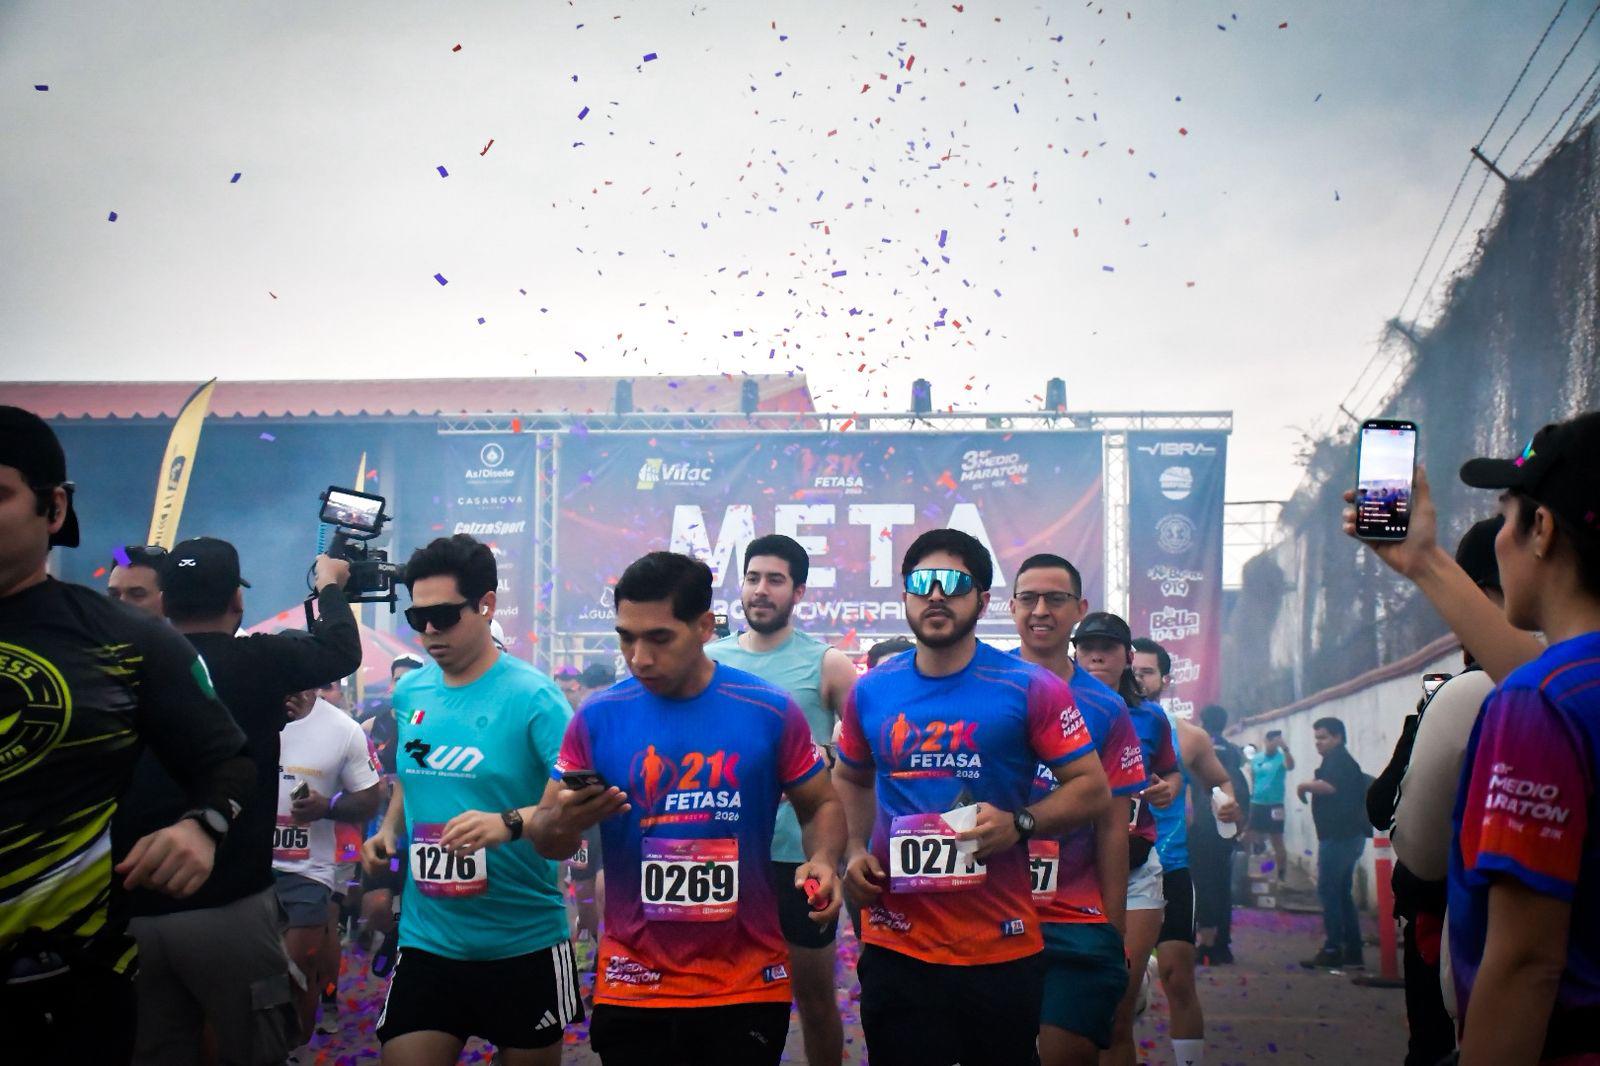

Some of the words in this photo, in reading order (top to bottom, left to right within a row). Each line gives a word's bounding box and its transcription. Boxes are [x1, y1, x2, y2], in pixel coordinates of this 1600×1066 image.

[1138, 442, 1216, 455] VIBRA
[662, 462, 712, 480] Vifac
[814, 476, 864, 488] FETASA
[457, 496, 523, 505] CASANOVA
[668, 503, 1007, 588] META
[1151, 611, 1199, 629] Bella
[920, 719, 981, 752] 21K
[677, 749, 740, 791] 21K
[910, 753, 982, 768] FETASA
[955, 770, 981, 779] 2026
[1489, 774, 1560, 800] MEDIO
[664, 791, 742, 811] FETASA
[714, 811, 741, 821] 2026
[416, 846, 476, 880] 1276
[901, 838, 985, 875] 027
[645, 863, 734, 903] 0269
